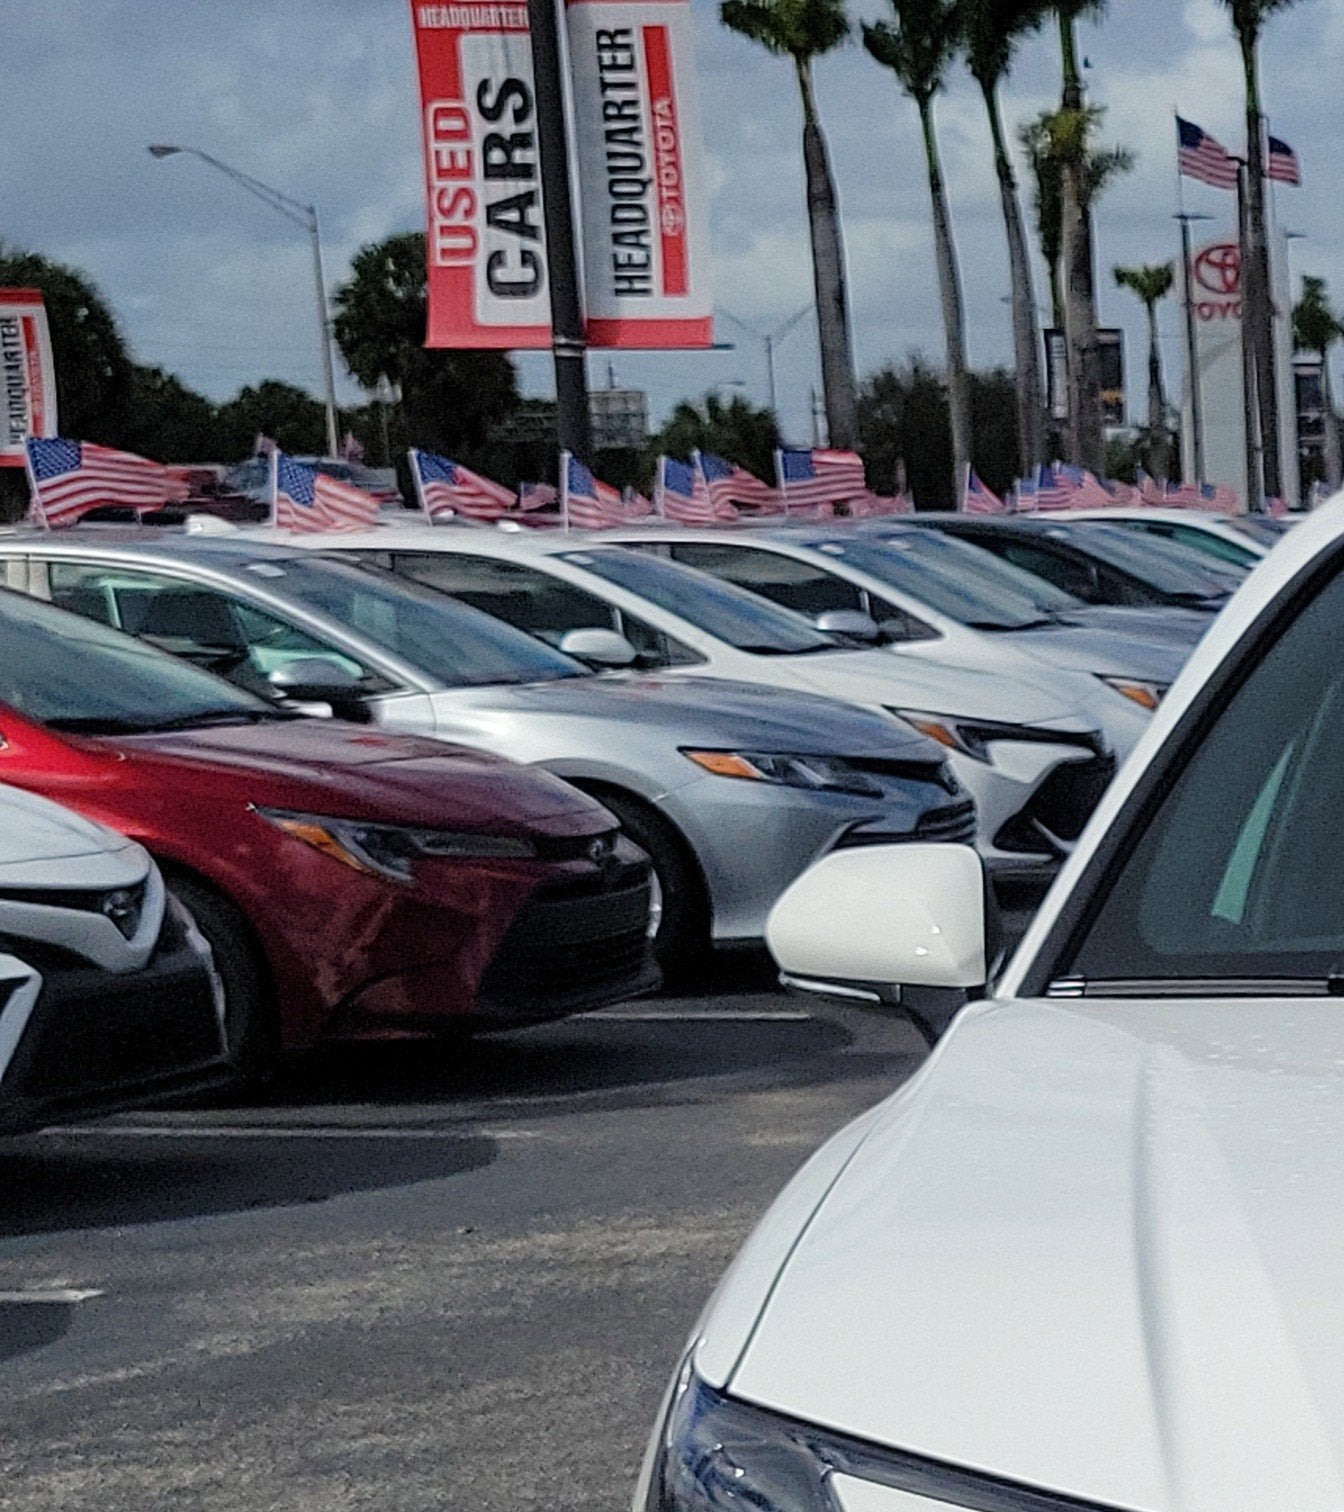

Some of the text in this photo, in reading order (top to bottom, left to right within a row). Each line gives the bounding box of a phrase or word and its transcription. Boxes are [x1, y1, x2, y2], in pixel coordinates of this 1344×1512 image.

[433, 104, 478, 263] USED
[477, 76, 541, 299] CARS
[596, 27, 655, 298] HEADQUARTER
[654, 97, 680, 198] TOYOTA
